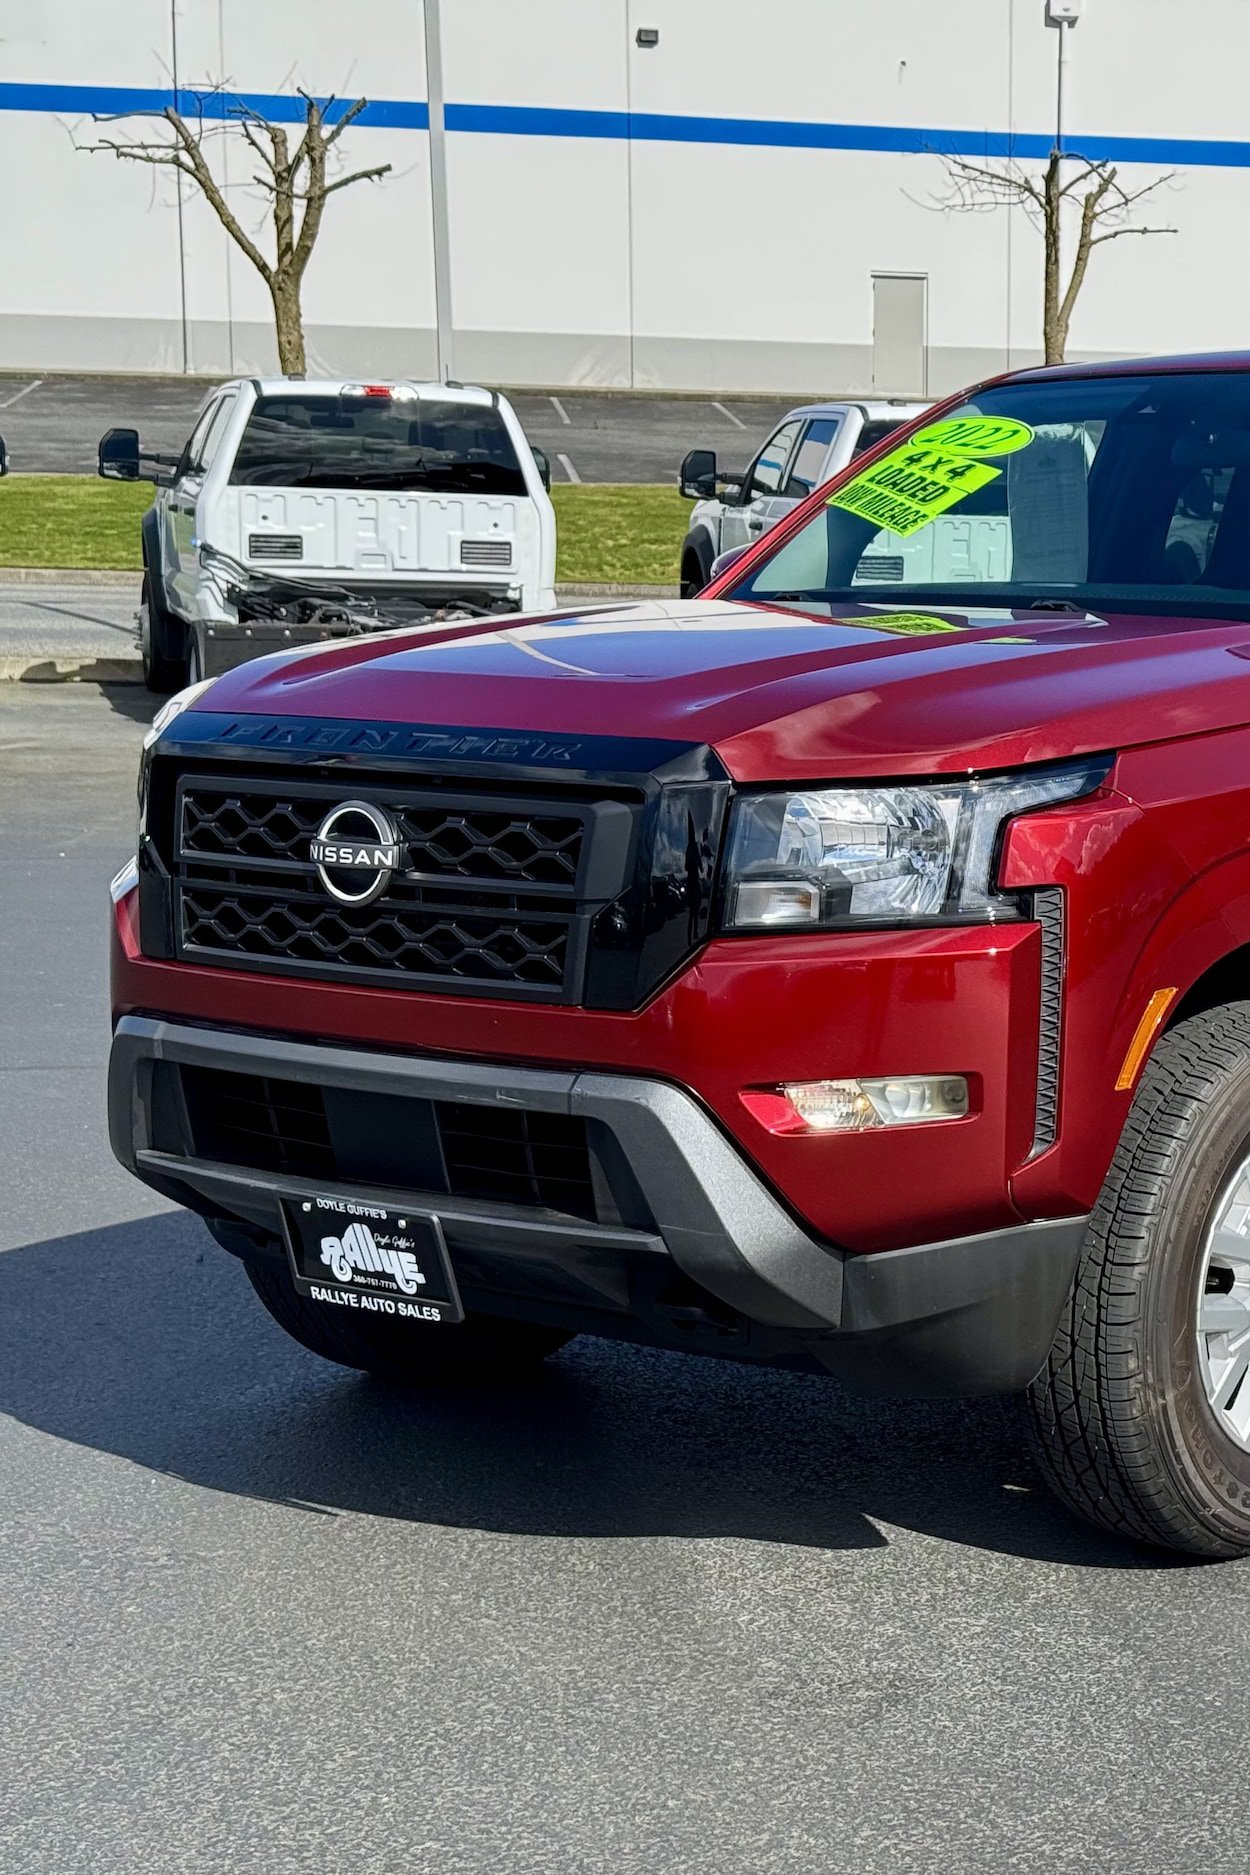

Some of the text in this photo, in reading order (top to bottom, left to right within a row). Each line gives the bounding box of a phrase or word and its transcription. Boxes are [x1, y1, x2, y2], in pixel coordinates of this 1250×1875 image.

[919, 422, 1021, 450] 2022
[863, 464, 951, 506] LOADED
[855, 492, 929, 533] MILEAGE
[219, 722, 582, 760] FRONTIER
[310, 844, 393, 867] NISSAN
[316, 1198, 346, 1212] DOYLE
[310, 1286, 441, 1321] RALLYE AUTO SALES
